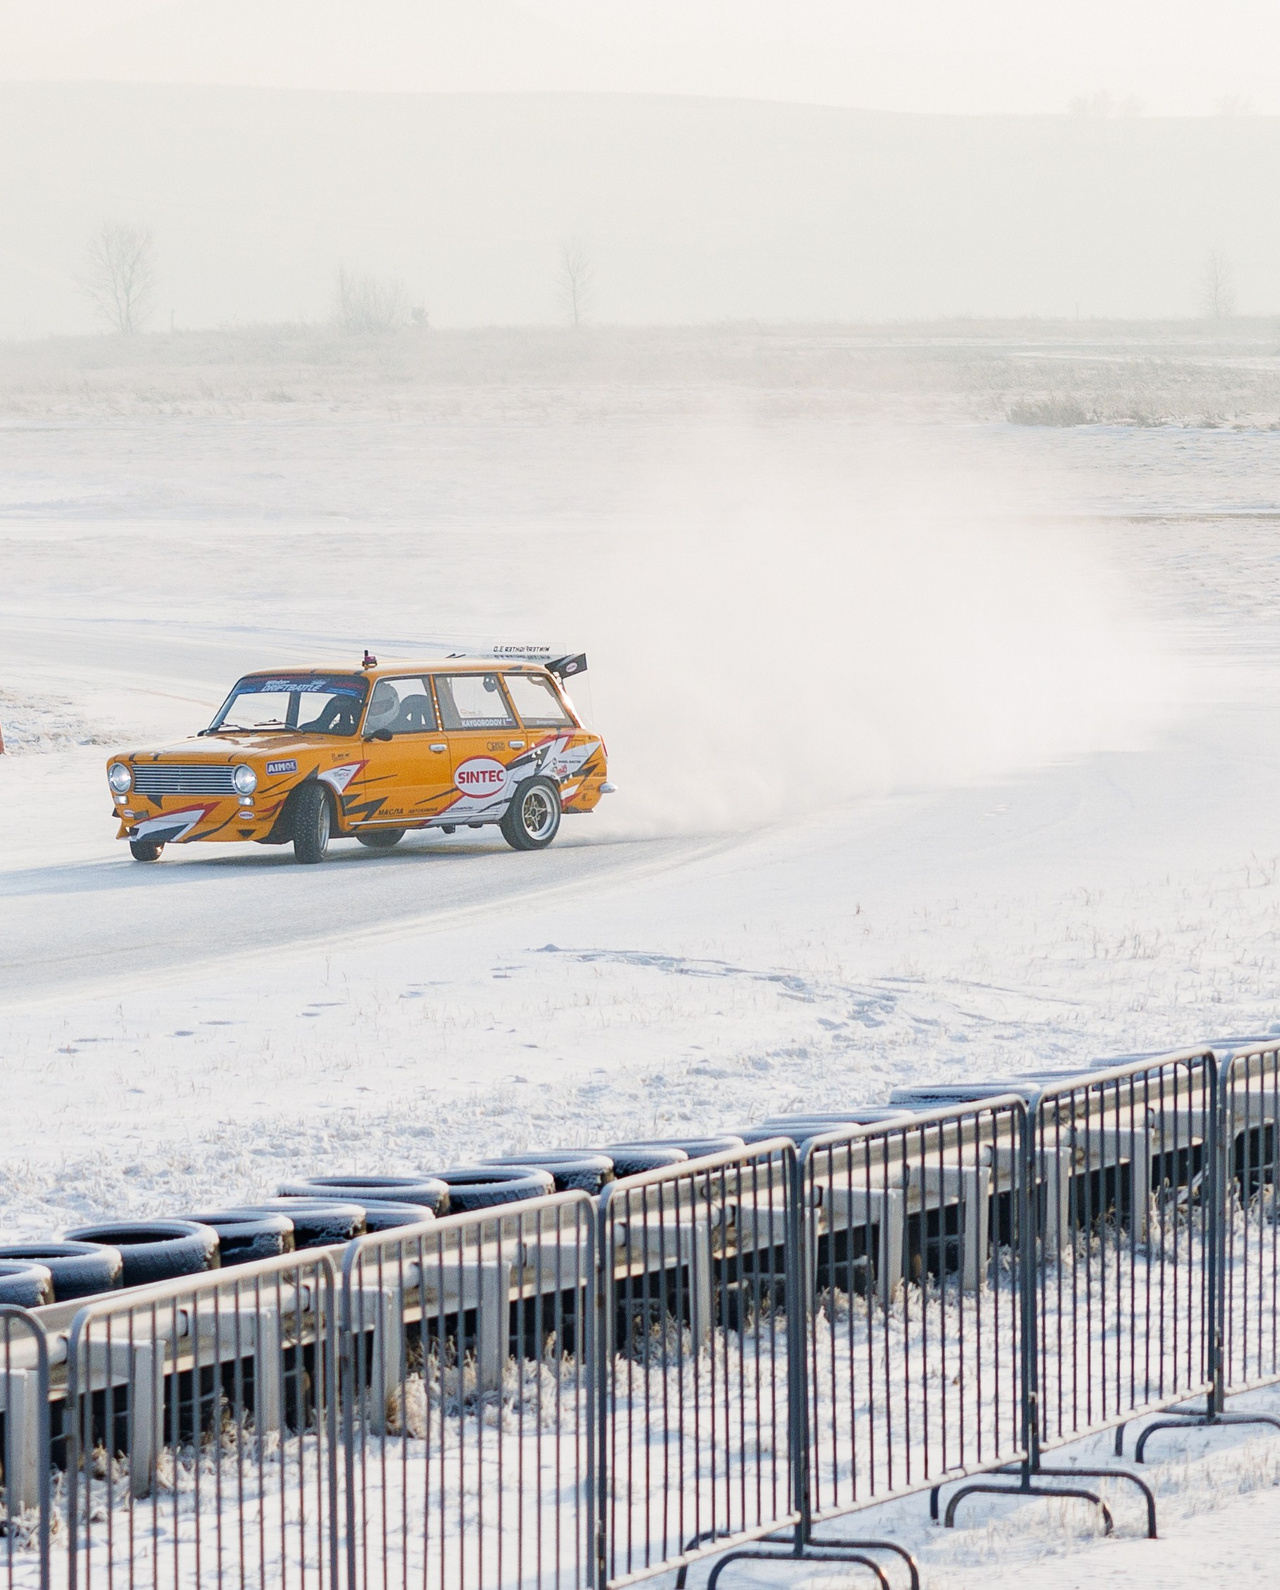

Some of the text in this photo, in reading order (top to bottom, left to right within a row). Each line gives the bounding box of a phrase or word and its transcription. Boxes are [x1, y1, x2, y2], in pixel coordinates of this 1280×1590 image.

[461, 718, 502, 727] KAYGORODOV
[268, 762, 296, 773] AIMOL
[458, 769, 504, 785] SINTEC
[377, 808, 404, 816] МАСЛА
